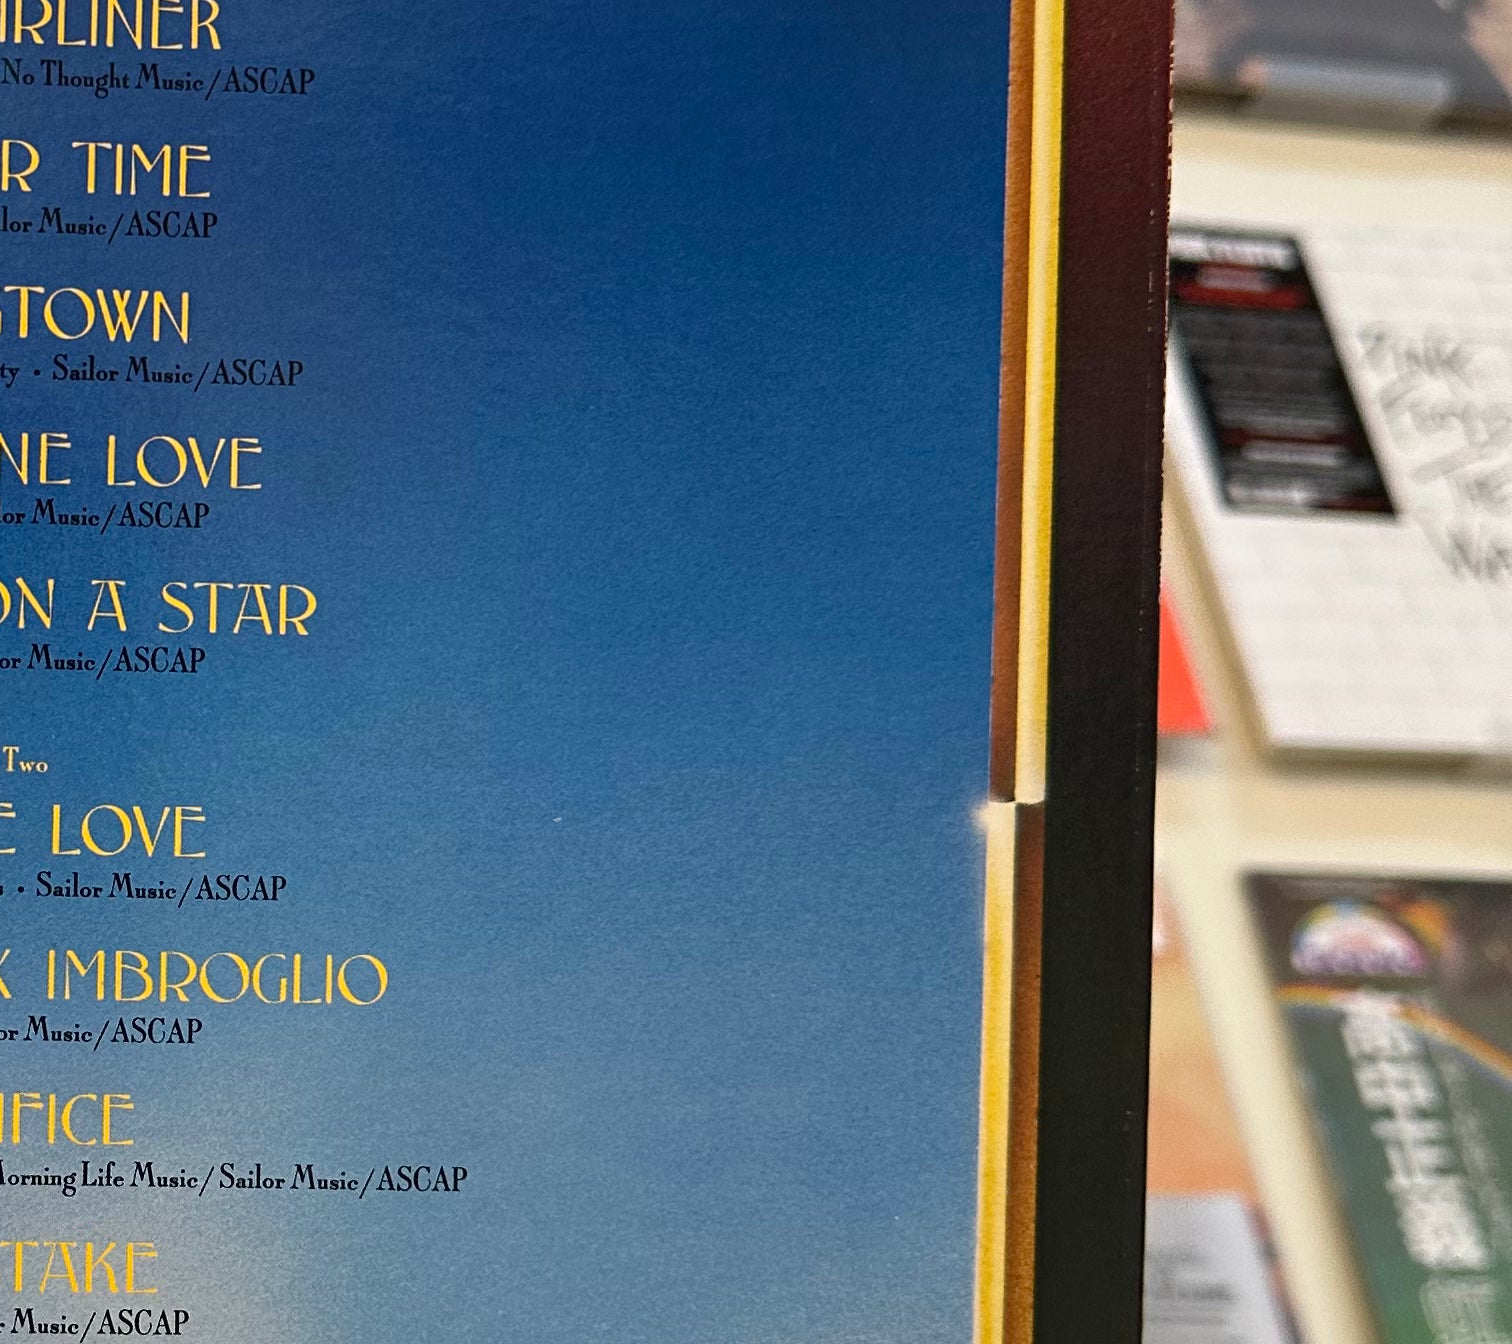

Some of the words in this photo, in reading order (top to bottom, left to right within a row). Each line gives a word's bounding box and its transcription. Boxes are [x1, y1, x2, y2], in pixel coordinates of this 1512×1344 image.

[40, 59, 129, 99] Thought
[72, 142, 211, 197] TIME
[53, 354, 119, 381] Sailor
[107, 435, 262, 489] LOVE
[88, 580, 127, 631] A
[159, 582, 317, 635] STAR
[2, 746, 48, 772] Two
[52, 804, 206, 857] LOVE
[36, 870, 103, 898] Sailor
[47, 950, 388, 1005] IMBROGLIO
[82, 1161, 124, 1187] Life
